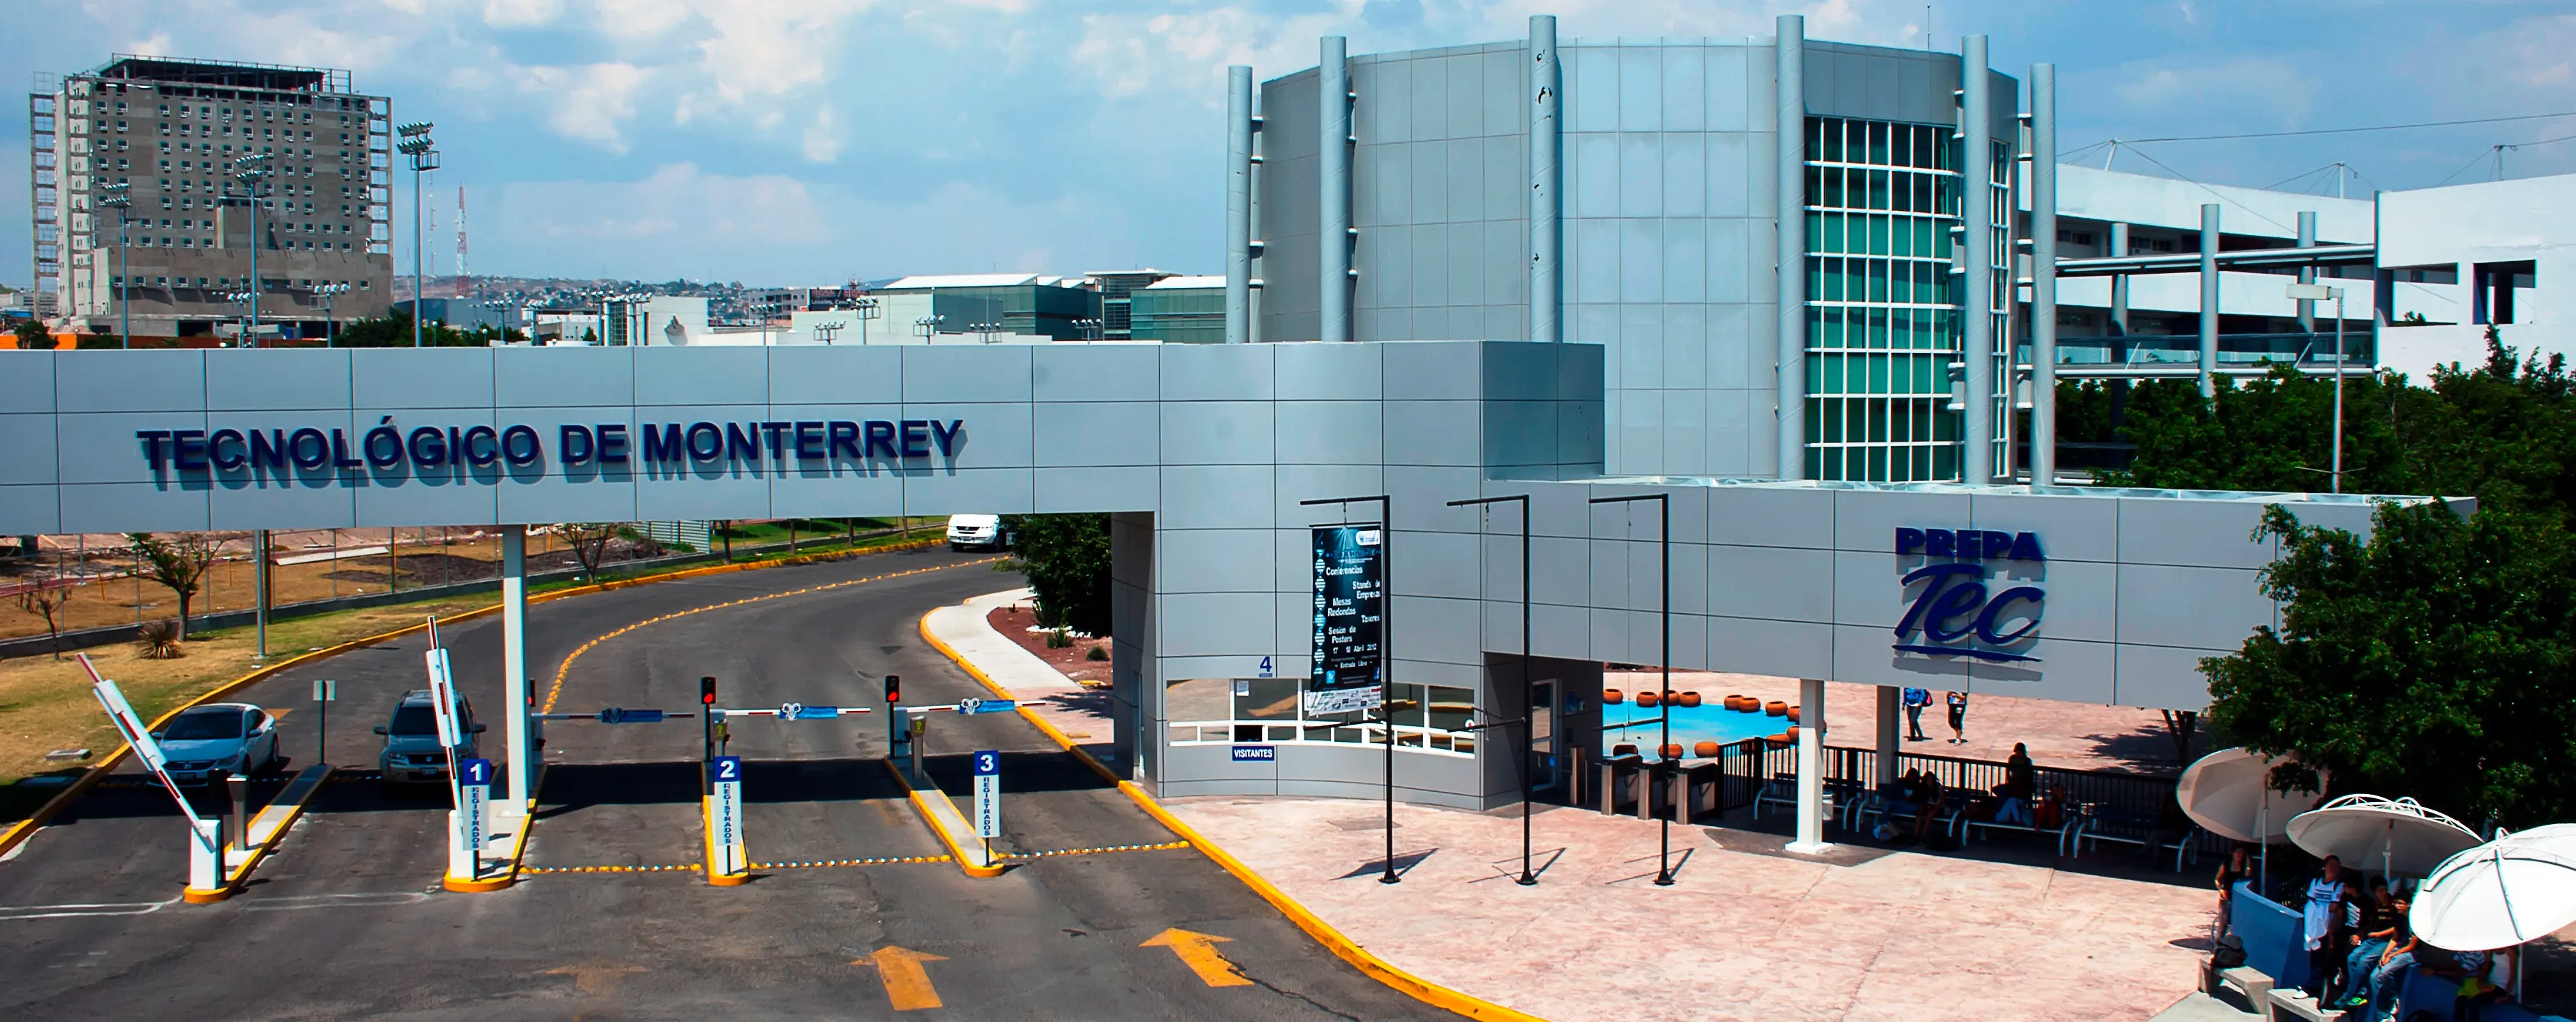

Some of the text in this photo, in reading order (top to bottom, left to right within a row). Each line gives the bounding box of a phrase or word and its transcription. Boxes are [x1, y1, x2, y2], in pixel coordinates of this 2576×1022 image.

[136, 415, 964, 472] TECNOLÓGICO DE MONTERREY
[1895, 527, 2045, 561] PREPA
[1327, 607, 1356, 617] Redondas
[1893, 562, 2046, 645] Tec
[1259, 656, 1272, 672] 4
[1234, 748, 1273, 758] VISITANTES
[470, 763, 481, 781] 1
[720, 760, 735, 778] 2
[980, 754, 994, 772] 3
[471, 787, 480, 848] REGISTRADOS
[724, 783, 732, 844] REGISTRADOS
